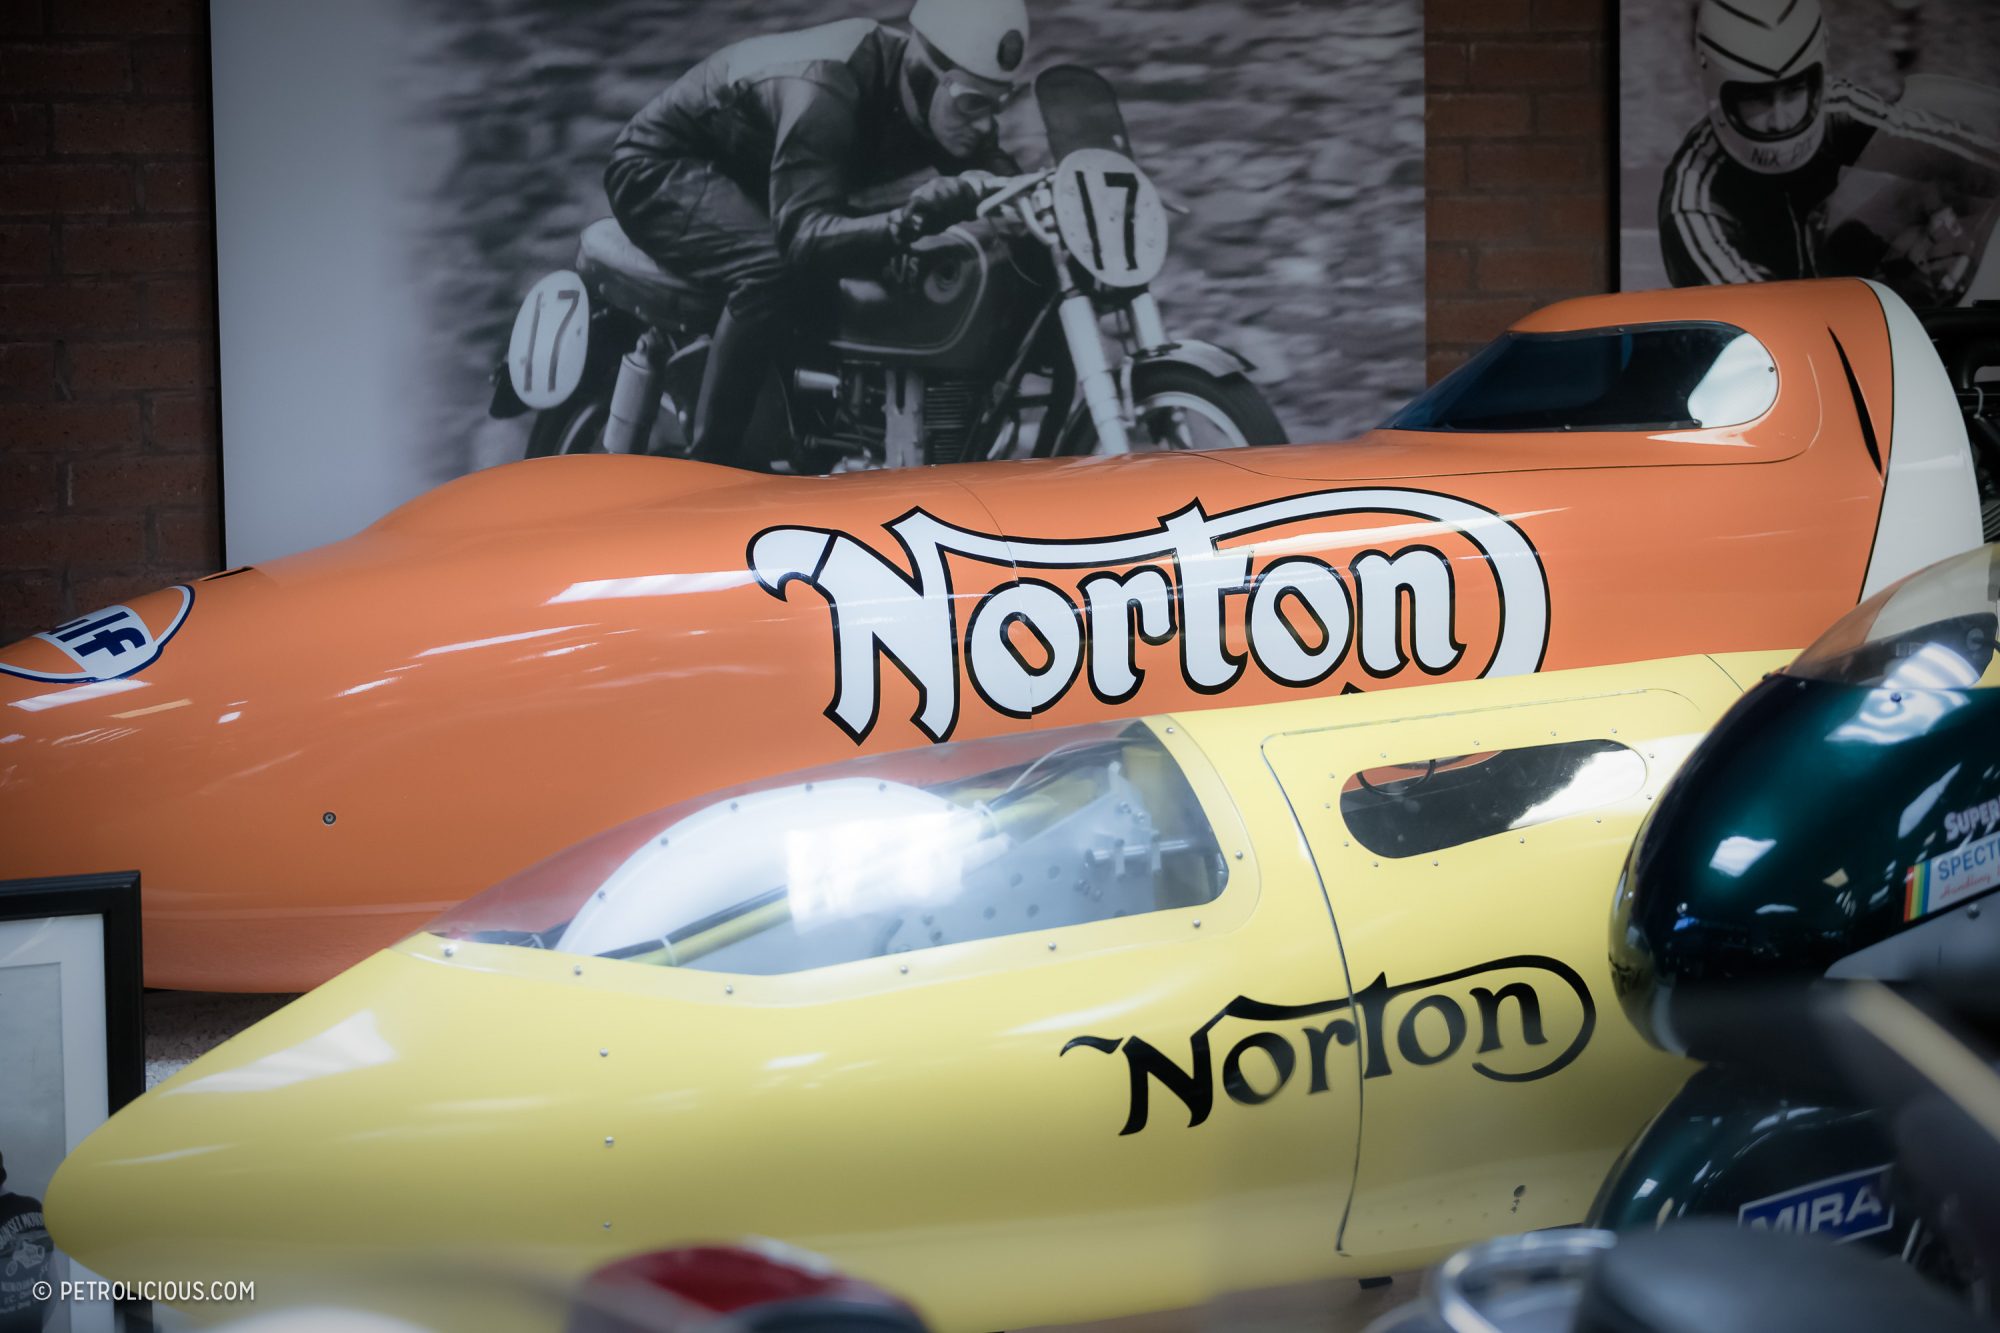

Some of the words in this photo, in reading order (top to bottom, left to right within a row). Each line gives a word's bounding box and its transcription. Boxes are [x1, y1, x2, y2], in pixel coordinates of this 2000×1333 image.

[1075, 169, 1138, 272] 17
[522, 289, 581, 394] 17
[745, 486, 1552, 745] Norton
[1944, 795, 2000, 842] SUPER
[1060, 954, 1597, 1136] Norton
